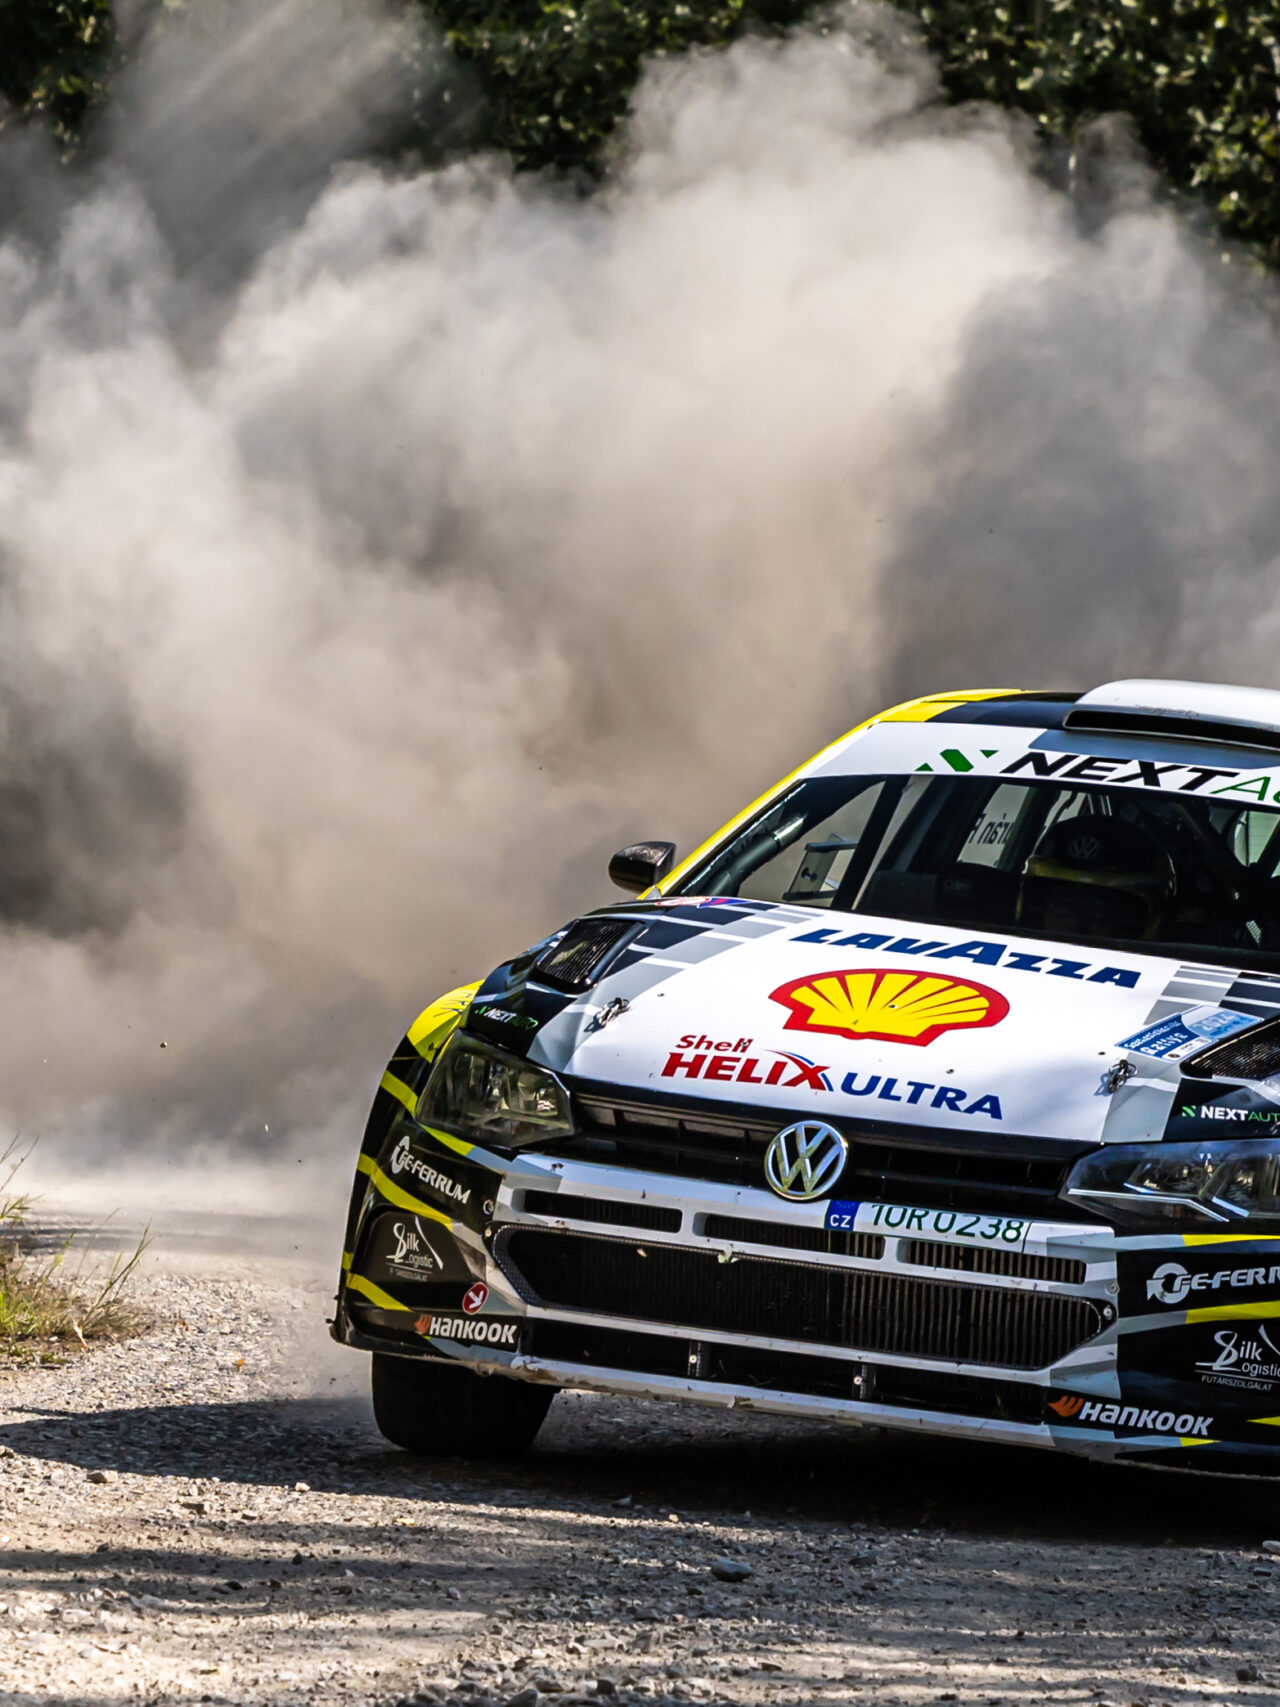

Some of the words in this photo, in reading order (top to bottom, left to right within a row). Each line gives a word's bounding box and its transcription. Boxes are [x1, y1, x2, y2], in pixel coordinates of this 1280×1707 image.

[788, 928, 1142, 989] LAVAZZA
[675, 1034, 754, 1053] Shell
[660, 1052, 835, 1093] HELIX
[838, 1072, 1003, 1121] ULTRA
[829, 1214, 851, 1228] CZ
